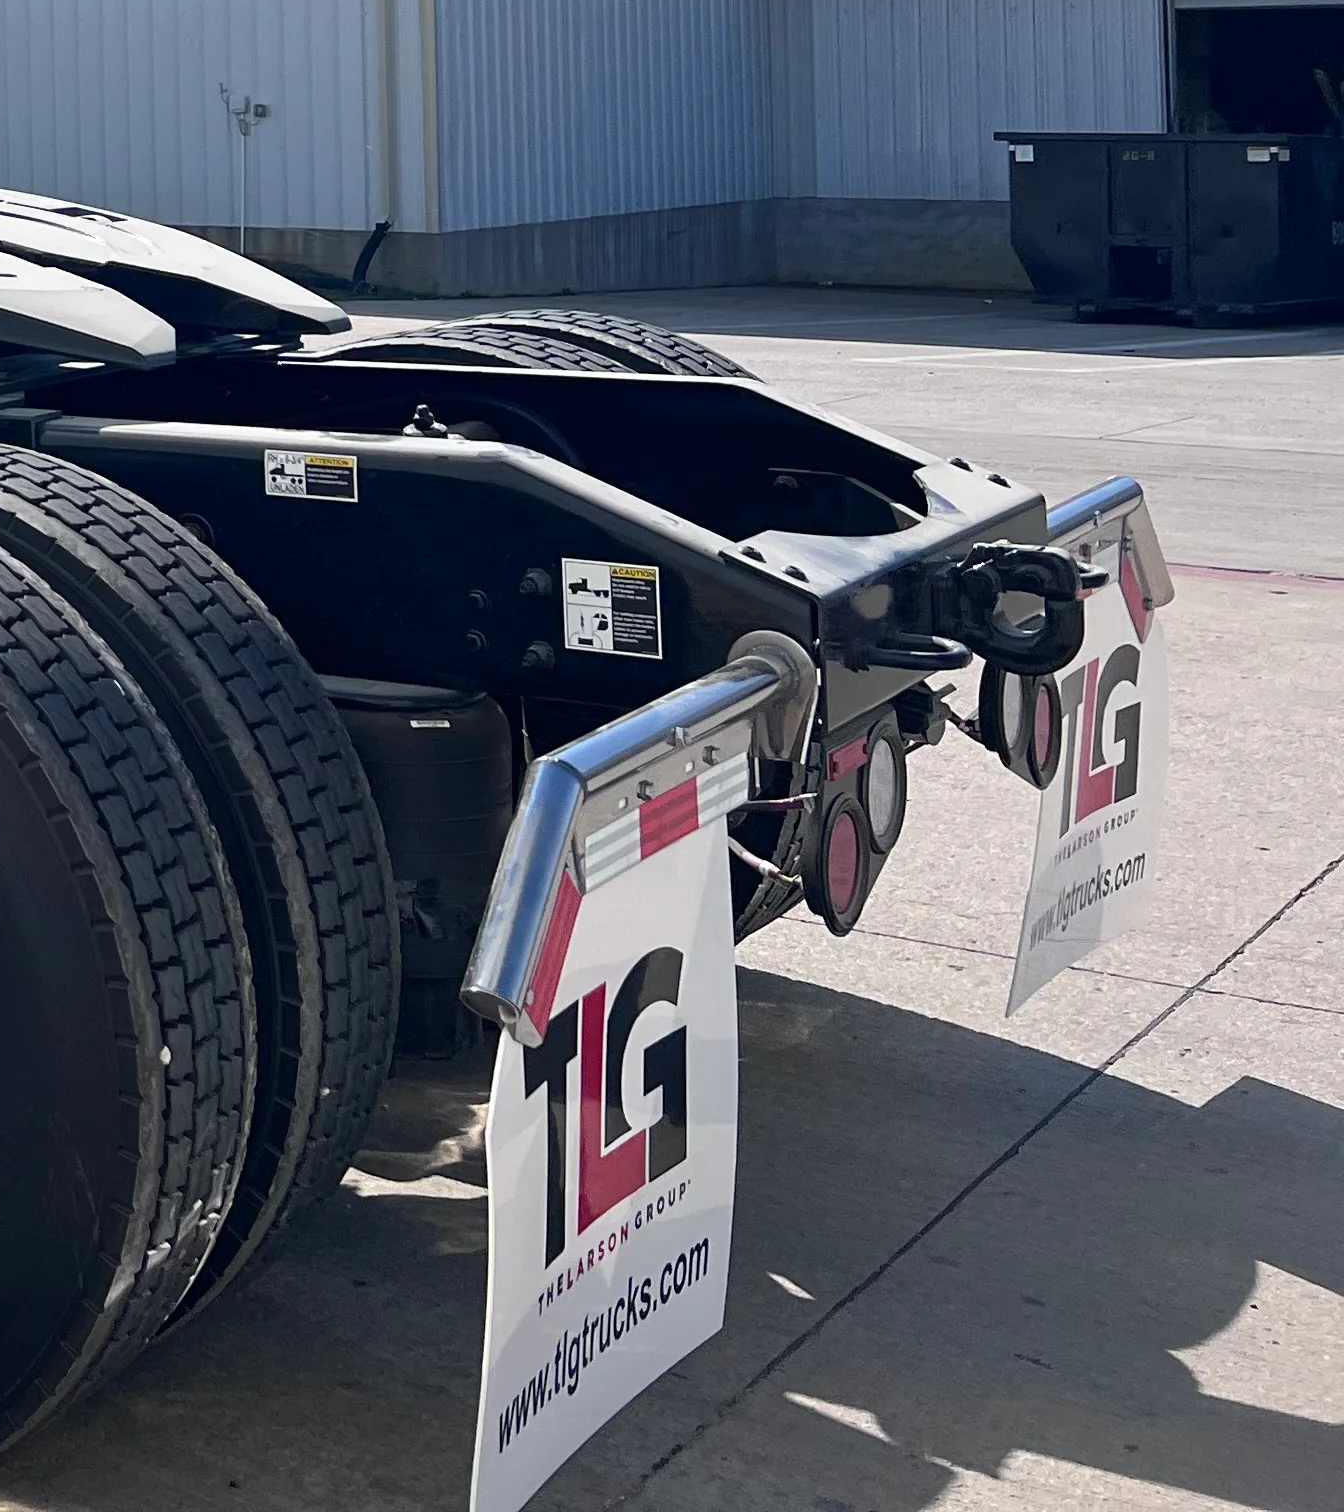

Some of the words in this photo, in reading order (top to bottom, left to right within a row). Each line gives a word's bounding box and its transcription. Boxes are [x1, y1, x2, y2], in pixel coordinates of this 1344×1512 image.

[620, 568, 655, 578] CAUTION
[1059, 643, 1142, 840] TLG
[1103, 809, 1137, 834] GROUP
[1029, 852, 1146, 952] www.tlgtrucks.com
[523, 945, 688, 1271] TLG
[634, 1180, 688, 1230] GROUP
[498, 1236, 710, 1455] www.tlgtrucks.com
